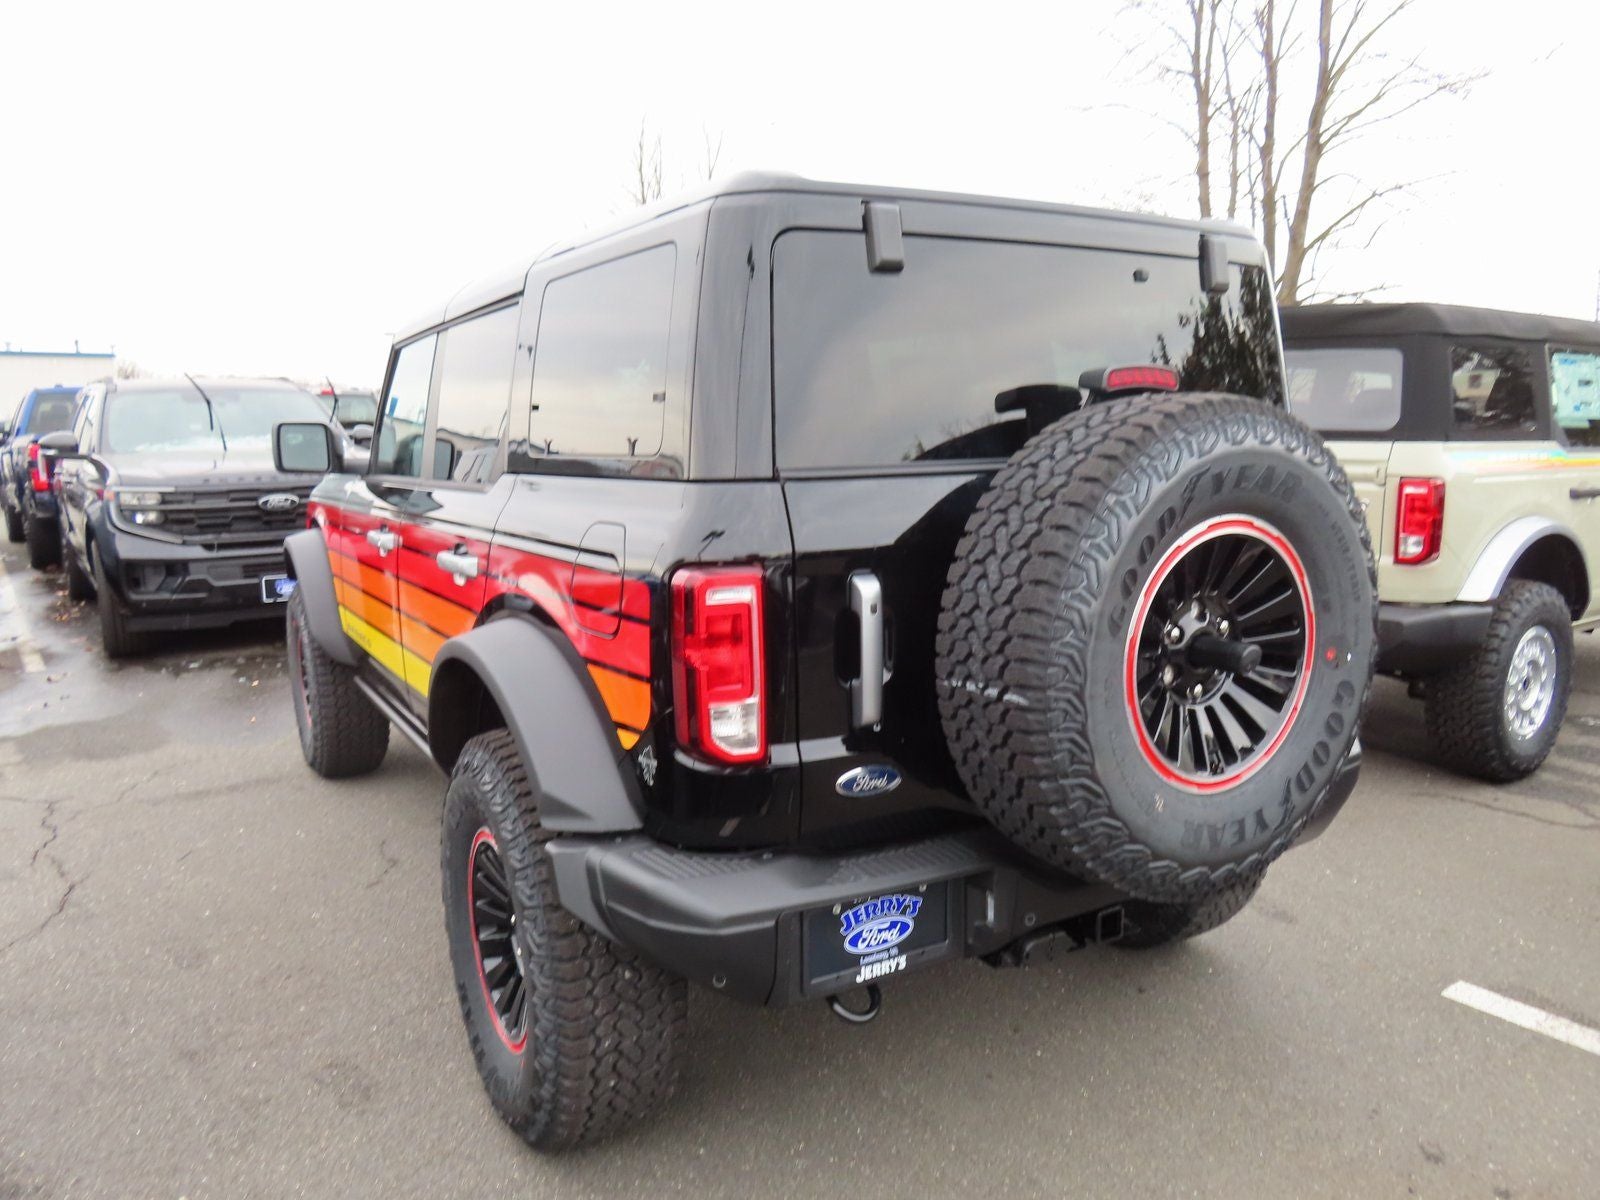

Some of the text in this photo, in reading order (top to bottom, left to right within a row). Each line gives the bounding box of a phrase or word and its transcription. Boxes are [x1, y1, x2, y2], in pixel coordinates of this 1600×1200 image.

[853, 773, 888, 792] Ford
[840, 893, 923, 936] JERRY'S
[858, 926, 900, 949] Ford
[856, 953, 907, 984] JERRY'S
